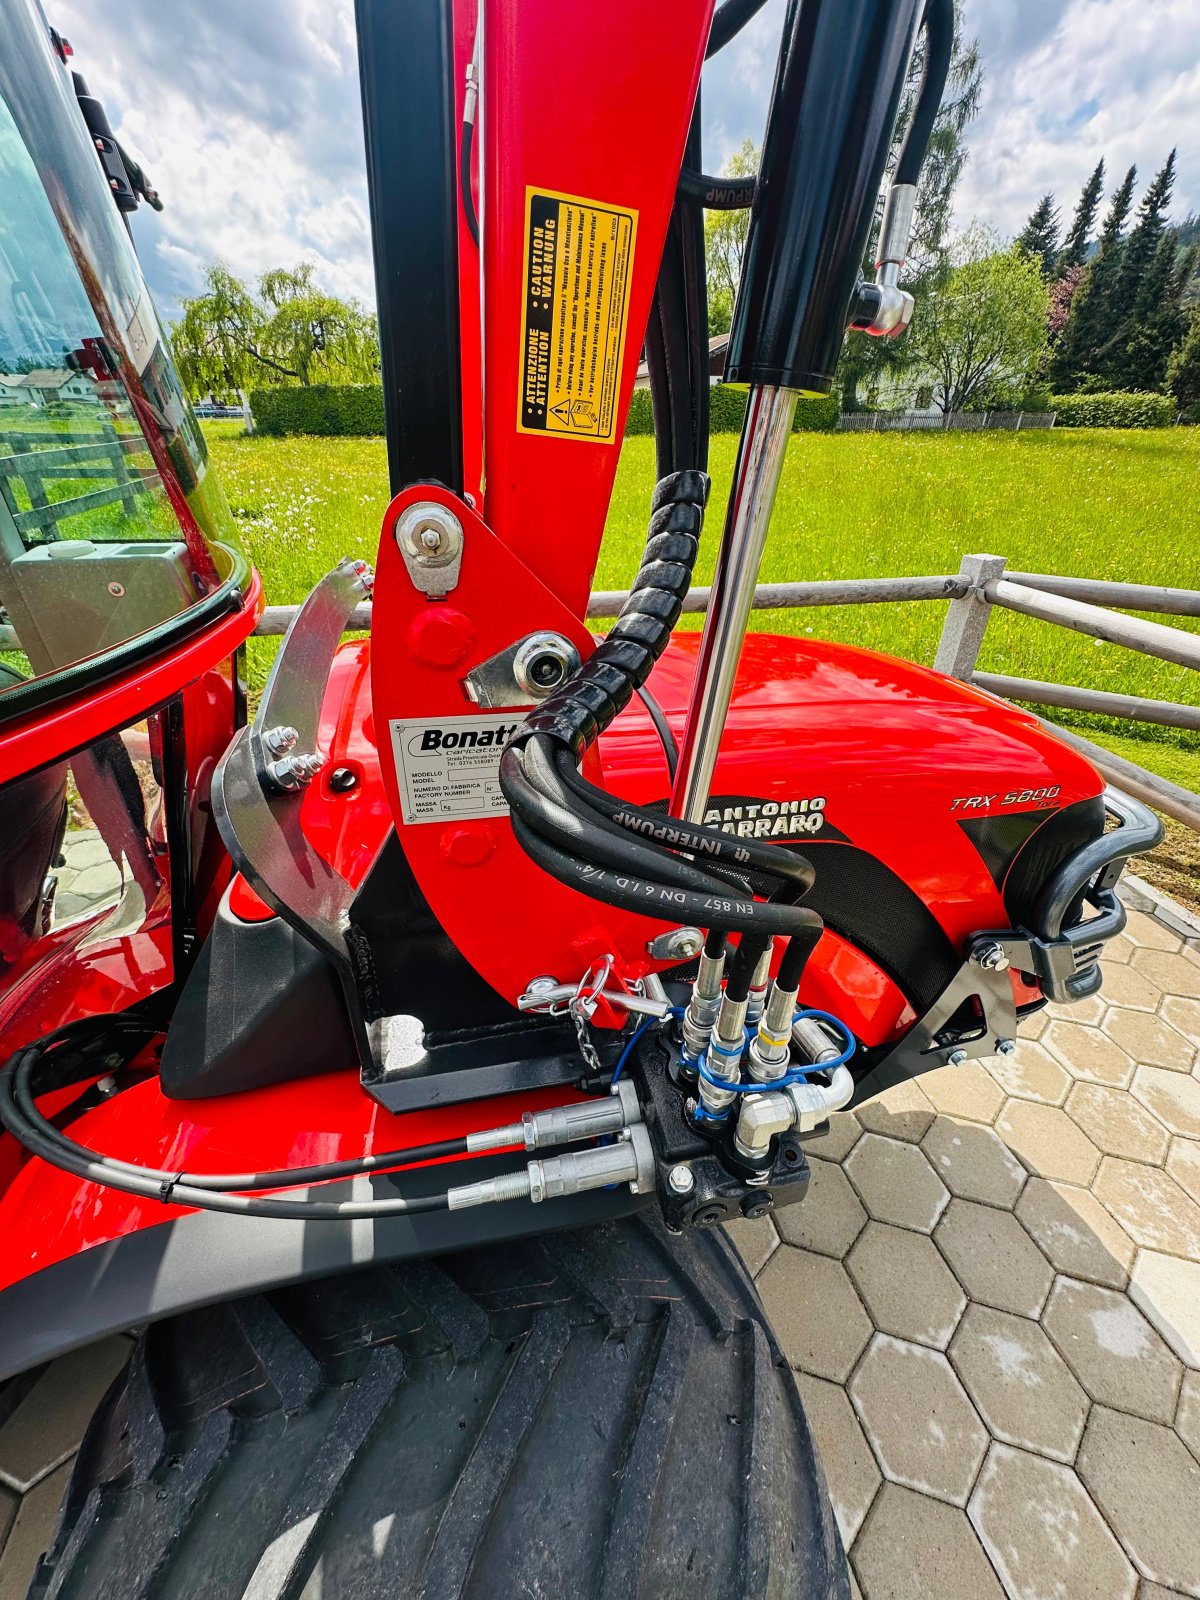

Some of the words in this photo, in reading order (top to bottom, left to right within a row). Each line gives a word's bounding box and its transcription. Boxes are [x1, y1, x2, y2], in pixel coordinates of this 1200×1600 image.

[705, 188, 753, 203] RPUMP
[532, 227, 544, 296] CAUTION
[542, 218, 555, 298] WARNUNG
[527, 328, 539, 404] ATTENZIONE
[536, 332, 549, 406] ATTENTION
[421, 725, 518, 750] Bonatt
[450, 782, 481, 790] FABBRICA
[950, 794, 998, 812] TRX
[1000, 784, 1062, 806] 5800
[703, 797, 826, 824] ANTONIO
[612, 811, 722, 856] INTERPUMP
[615, 874, 640, 892] I.D.
[645, 886, 655, 896] 6
[660, 889, 686, 903] DN
[704, 898, 731, 912] 857
[736, 902, 754, 915] EN
